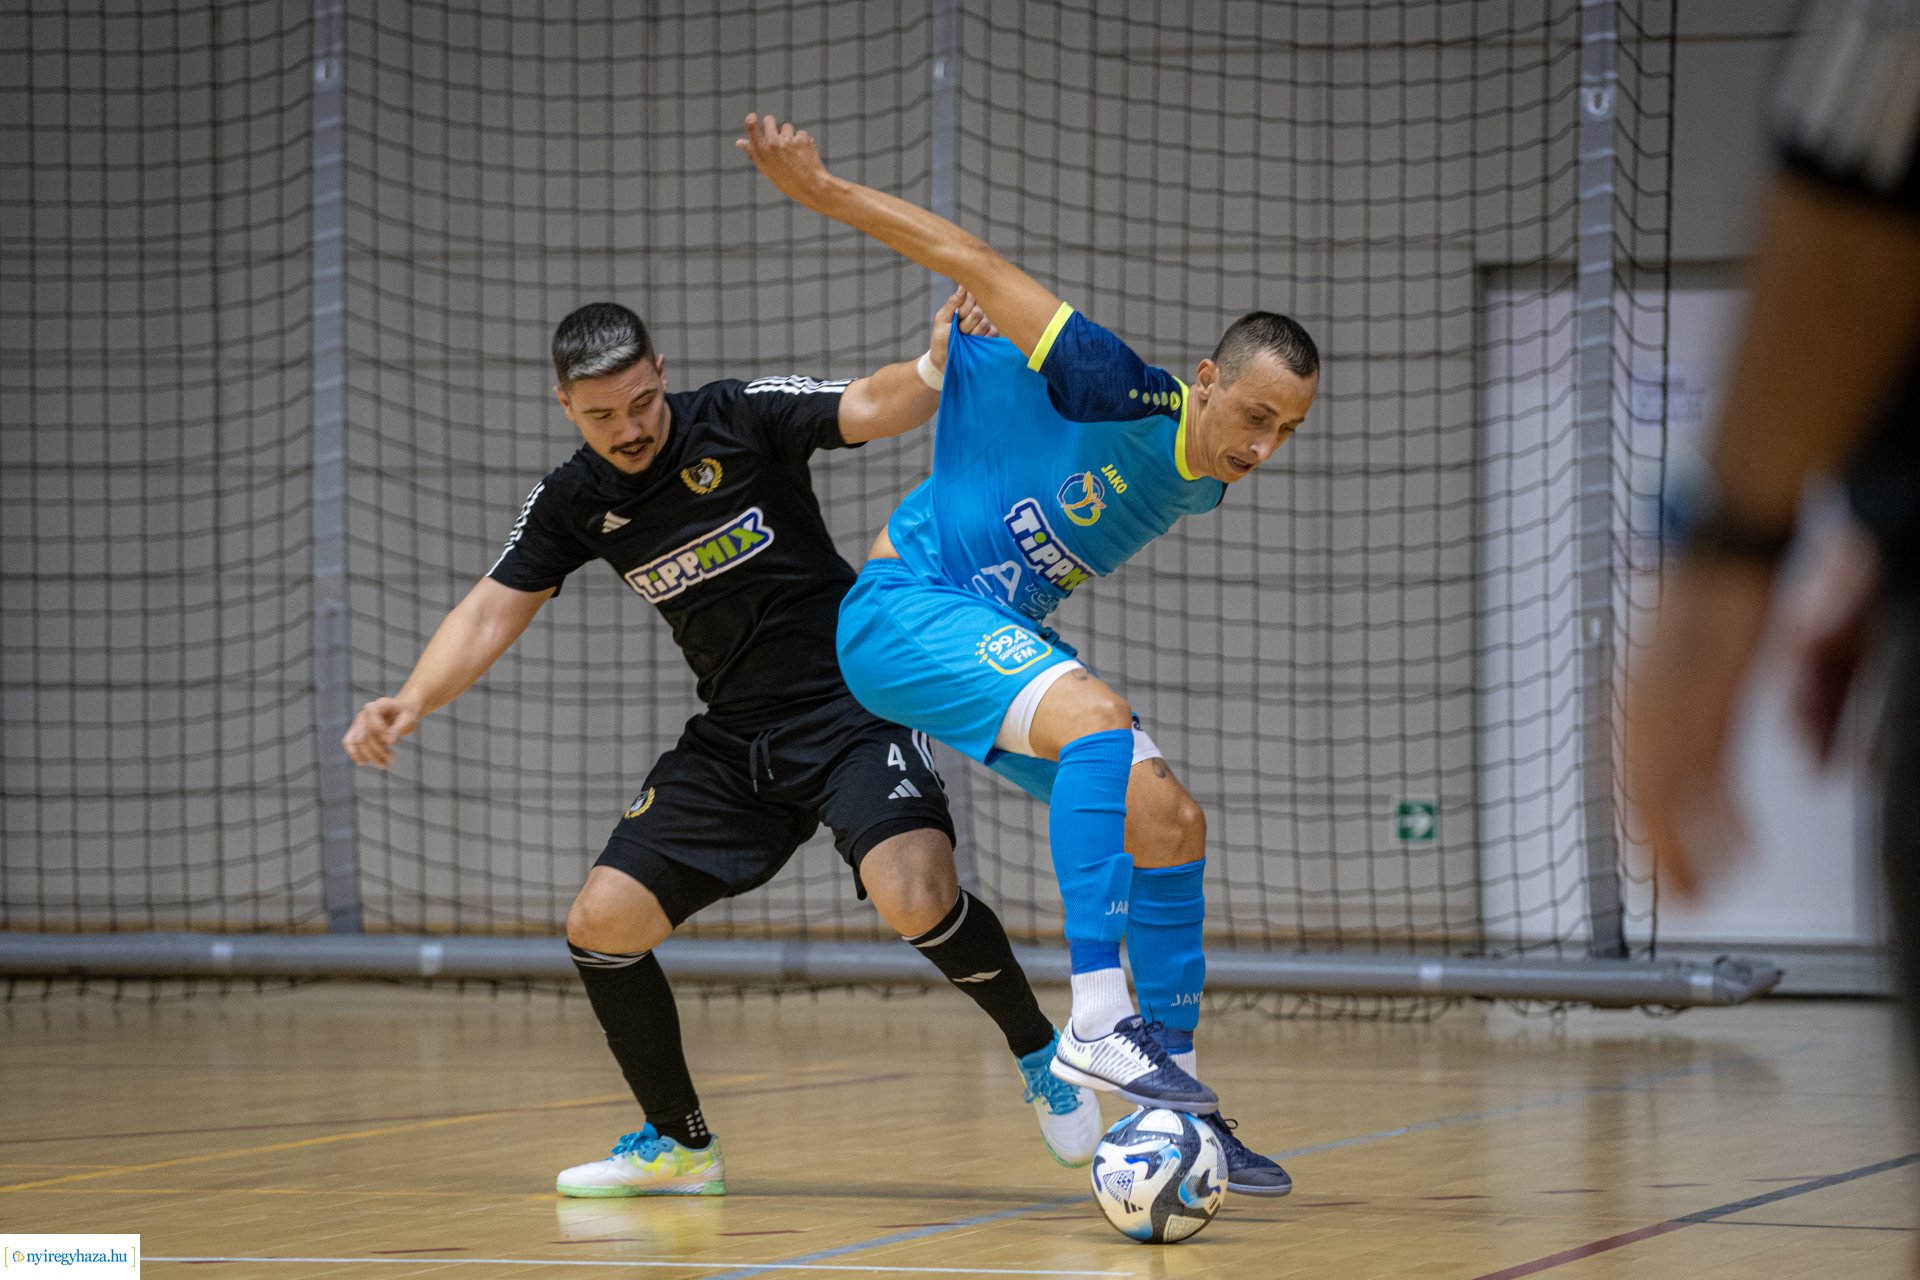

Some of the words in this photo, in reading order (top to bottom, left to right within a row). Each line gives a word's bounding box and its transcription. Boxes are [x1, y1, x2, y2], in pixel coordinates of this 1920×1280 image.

[1100, 463, 1128, 495] JAKO
[1012, 646, 1037, 663] FM
[887, 742, 906, 771] 4
